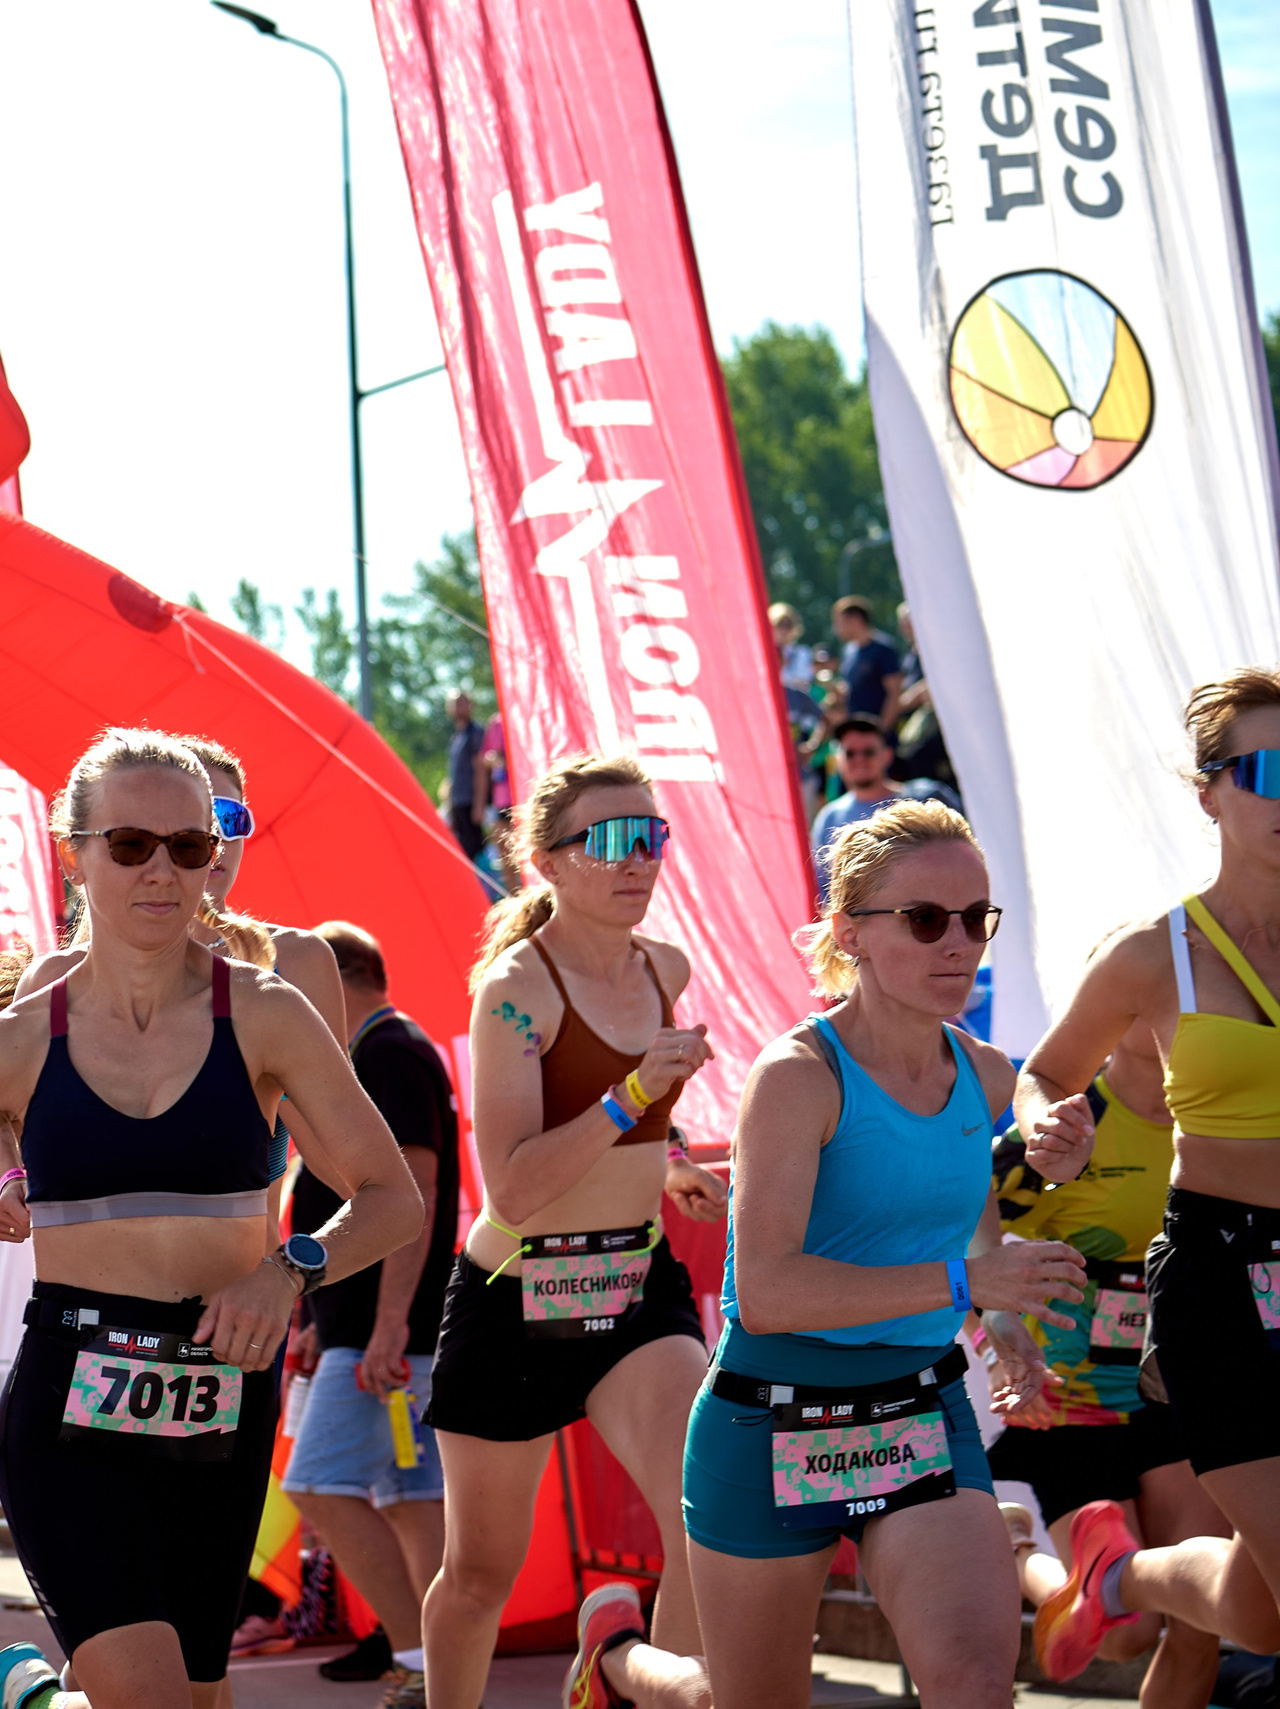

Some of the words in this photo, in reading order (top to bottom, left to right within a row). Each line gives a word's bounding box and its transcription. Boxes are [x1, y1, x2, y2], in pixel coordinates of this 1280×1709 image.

[544, 1237, 562, 1247] IRON
[569, 1236, 587, 1247] LADY
[583, 1318, 615, 1331] 7002
[108, 1331, 128, 1344] IRON
[136, 1335, 160, 1349] LADY
[97, 1366, 220, 1423] 7013
[802, 1406, 823, 1418] IRON
[832, 1404, 854, 1416] LADY
[805, 1443, 916, 1476] ХОДАКОВА
[846, 1498, 886, 1516] 7009
